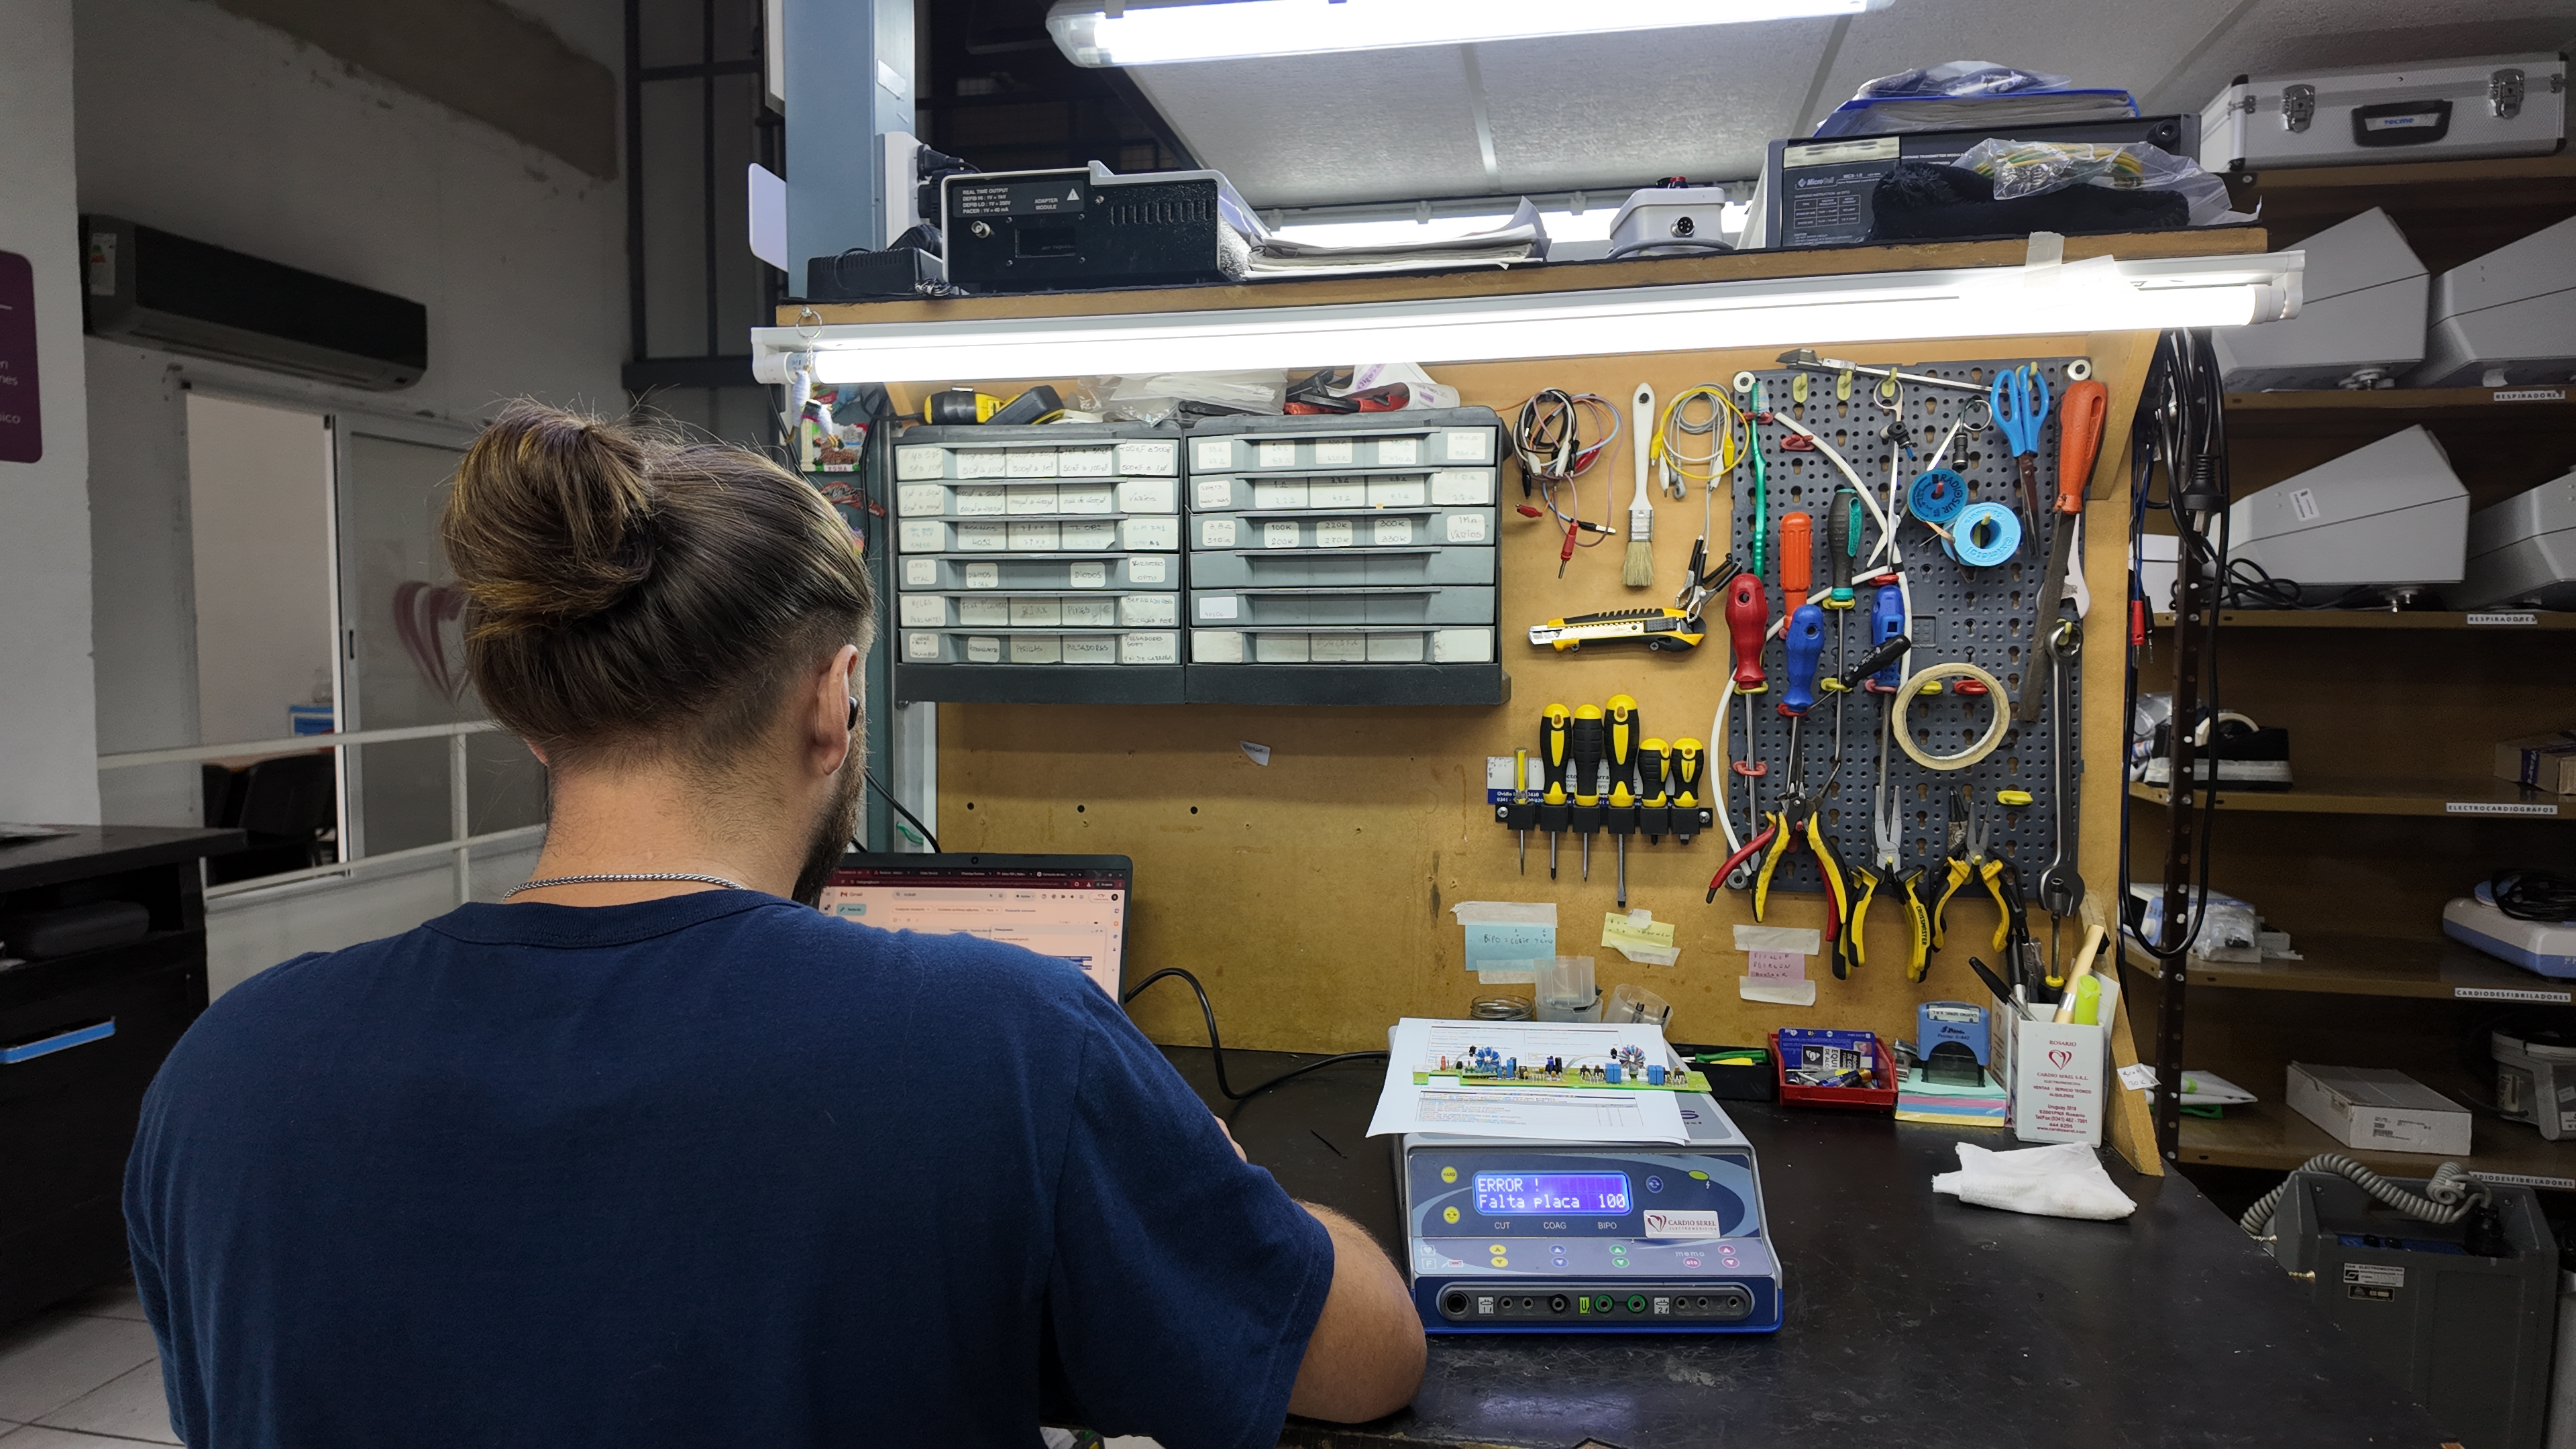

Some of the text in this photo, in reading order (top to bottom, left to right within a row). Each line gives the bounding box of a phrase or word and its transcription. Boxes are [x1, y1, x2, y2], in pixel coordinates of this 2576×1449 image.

[2496, 392, 2563, 400] RESPIRADORES
[1939, 473, 1964, 514] RADIOSUR
[2469, 615, 2536, 623] RESPIRADORES
[2448, 804, 2555, 814] ELECTROCARDIOGRAFOS
[1915, 905, 1927, 946] CROSSMASTER
[2456, 989, 2570, 1002] CARDIODESFIBRILADORES
[1478, 1177, 1539, 1193] ERROR !
[1479, 1193, 1626, 1209] Falta placa 100
[1494, 1222, 1510, 1230] CUT
[1543, 1222, 1567, 1230] COAG
[1597, 1222, 1617, 1230] BIPO
